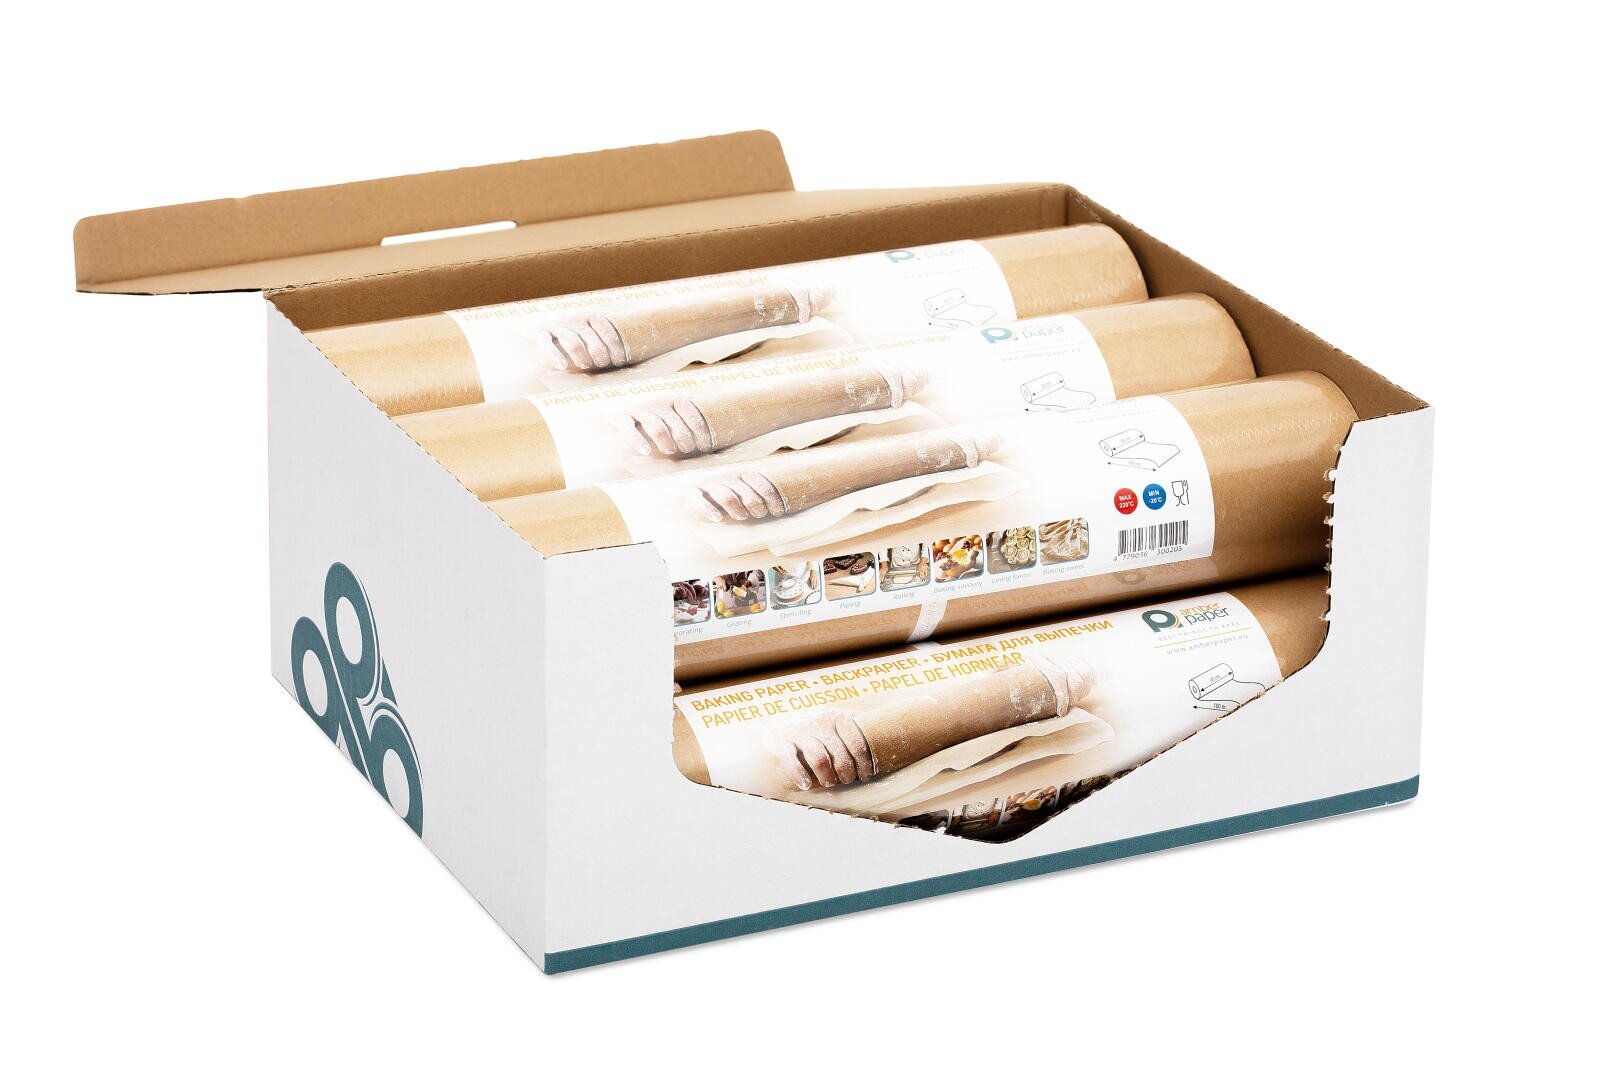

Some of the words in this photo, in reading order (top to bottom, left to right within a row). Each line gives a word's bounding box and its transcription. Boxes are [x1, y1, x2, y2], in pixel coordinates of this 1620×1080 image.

[1118, 493, 1132, 501] MAX
[1122, 550, 1148, 560] 779036
[1156, 545, 1183, 556] 300205
[1179, 602, 1220, 616] amber
[1184, 607, 1230, 625] paper
[931, 642, 998, 664] БУМАГА
[999, 635, 1036, 654] ДЛЯ
[1036, 620, 1114, 642] ВЫПЕЧКИ
[691, 691, 754, 712] BAKING
[755, 680, 811, 700] PAPER
[820, 657, 920, 685] BACKPAPIER
[702, 705, 761, 729] PAPIER
[763, 700, 788, 717] DE
[789, 685, 860, 711] CUISSON
[870, 672, 925, 694] PAPEL
[926, 666, 947, 684] DE
[947, 652, 1025, 678] HORNEAR
